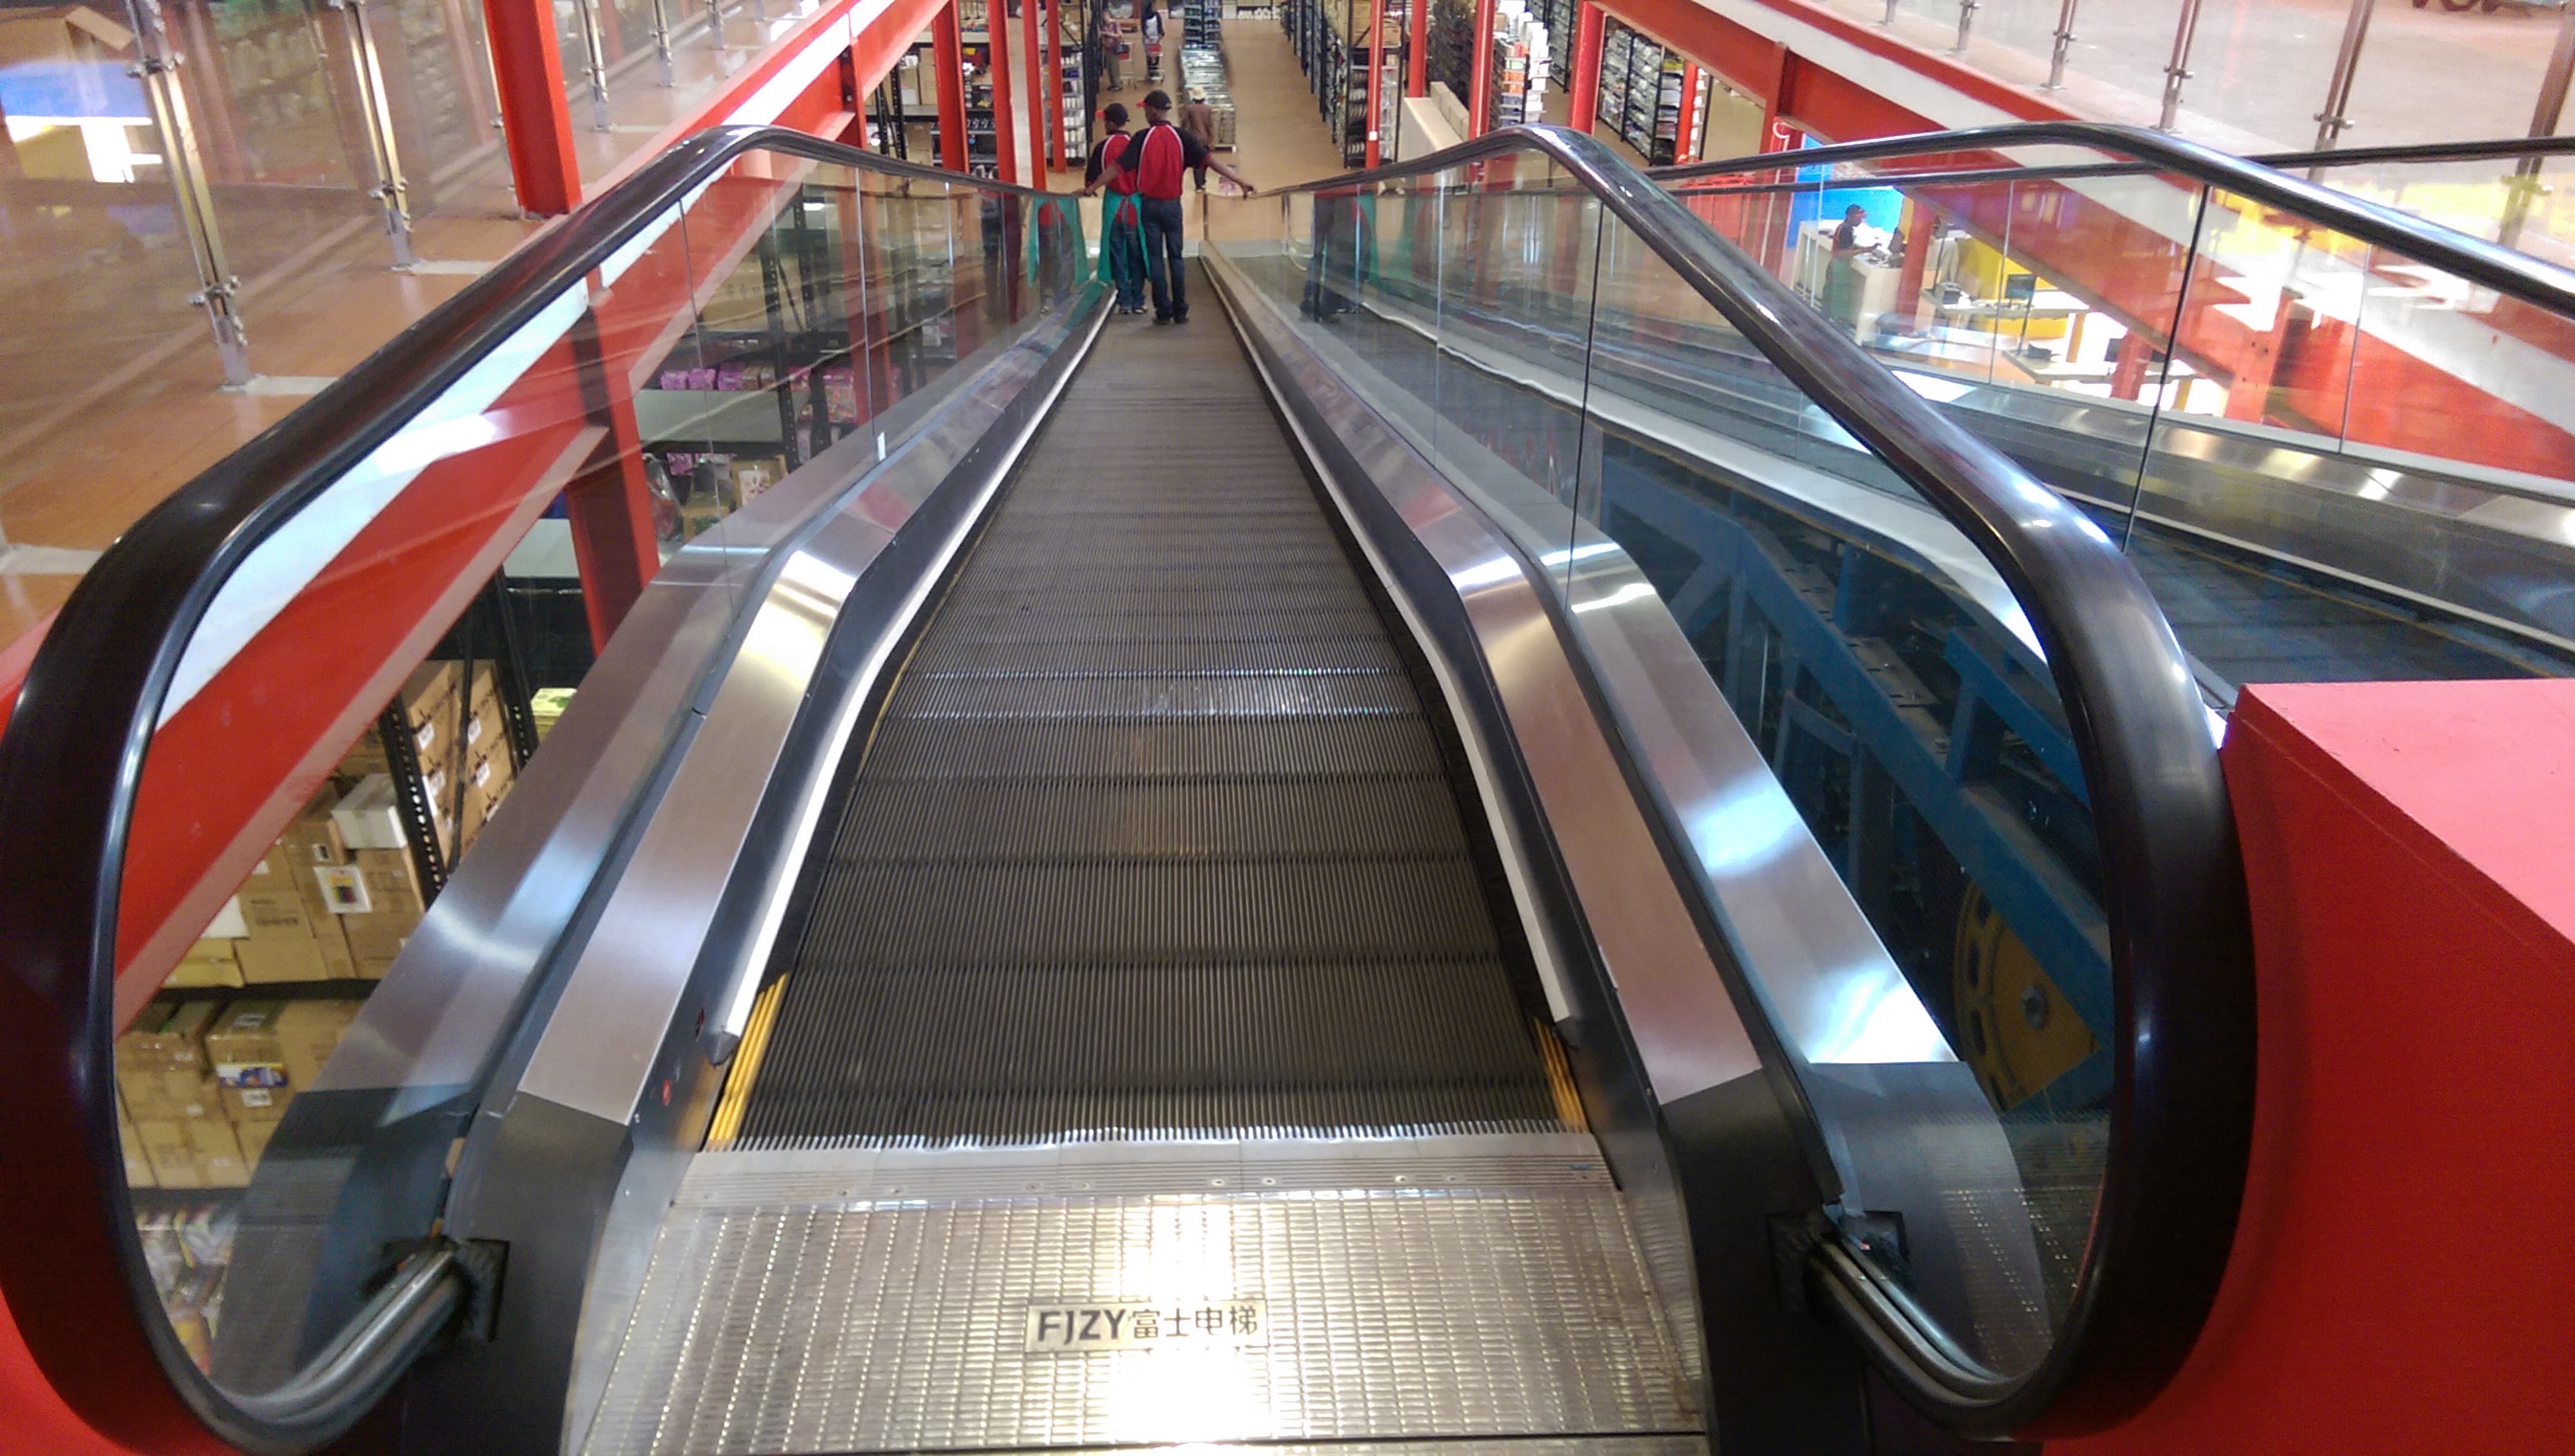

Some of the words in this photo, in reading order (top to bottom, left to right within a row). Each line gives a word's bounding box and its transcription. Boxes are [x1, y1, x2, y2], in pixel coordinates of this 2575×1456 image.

[1037, 1309, 1126, 1345] FJZY
[1128, 1306, 1258, 1339] 富士电梯
